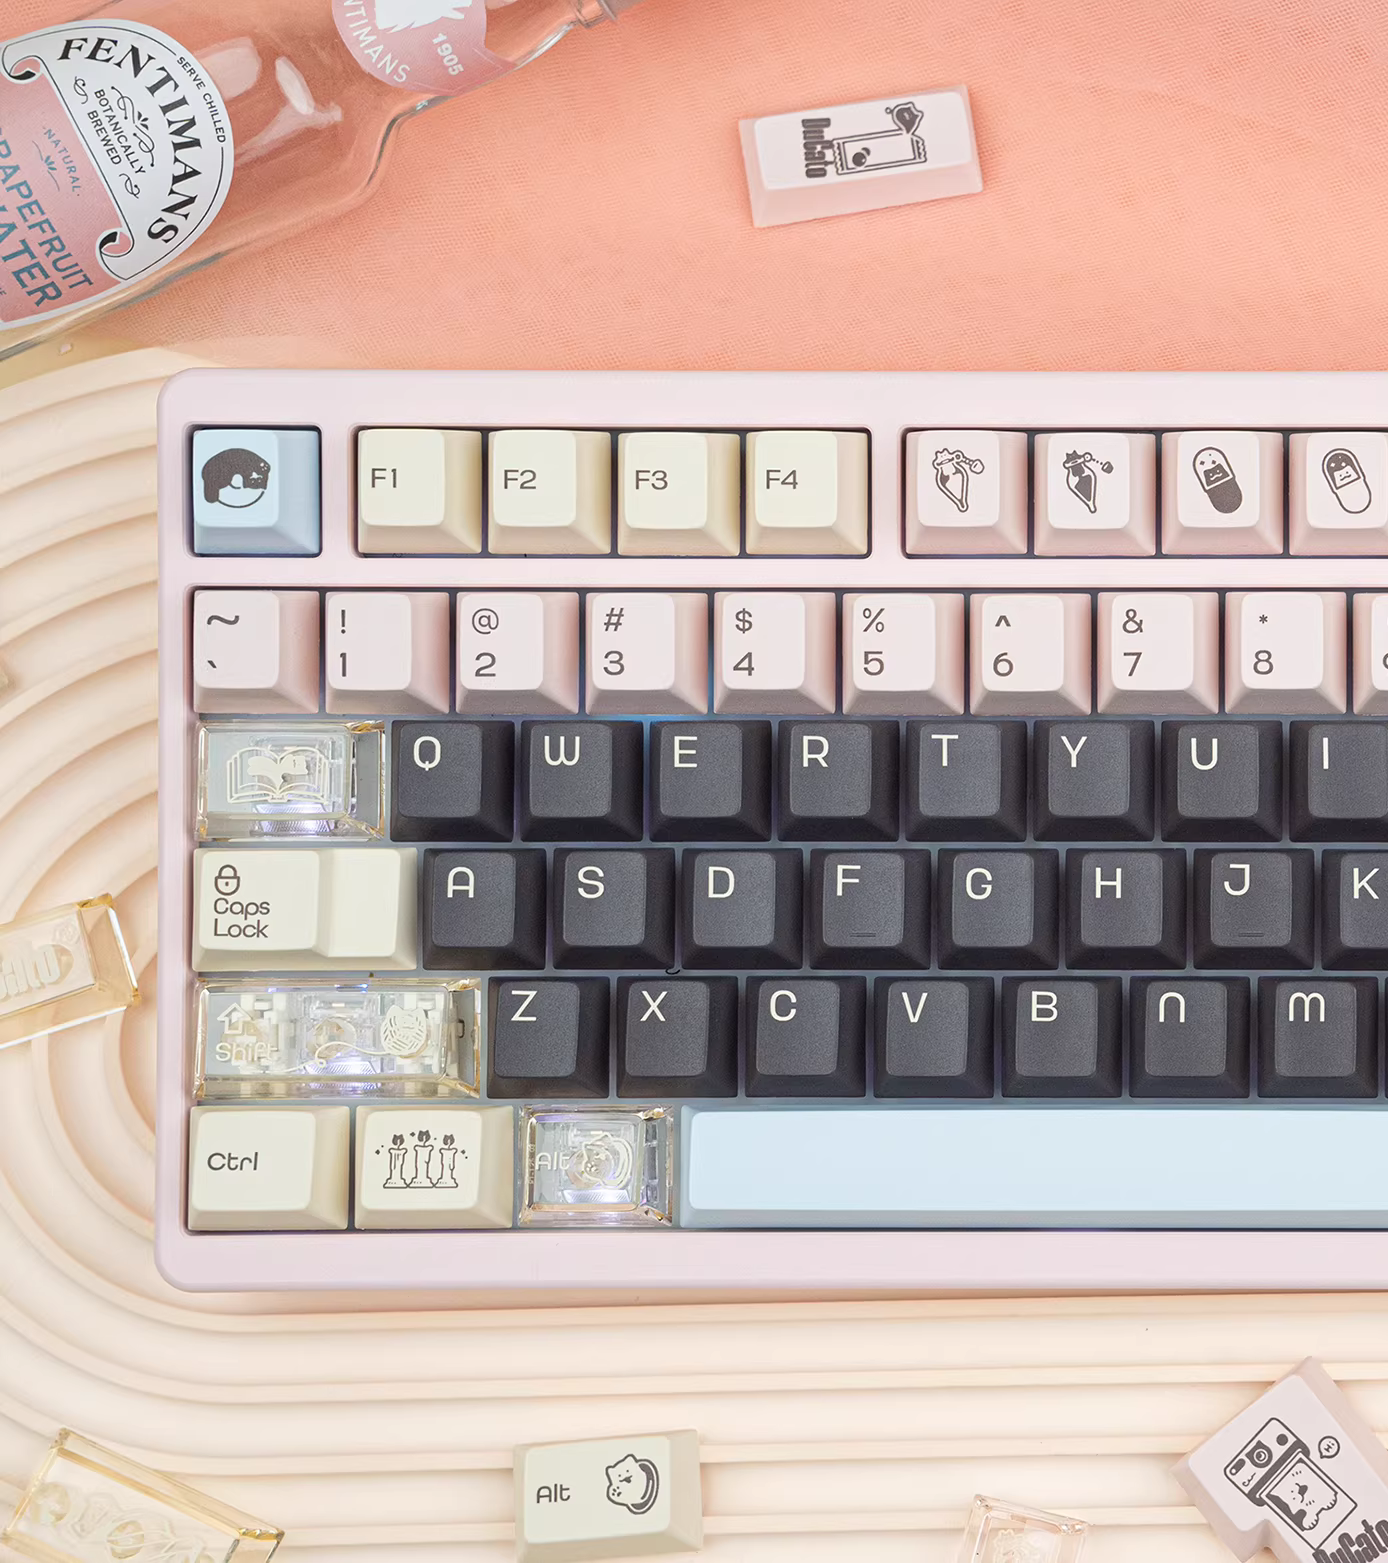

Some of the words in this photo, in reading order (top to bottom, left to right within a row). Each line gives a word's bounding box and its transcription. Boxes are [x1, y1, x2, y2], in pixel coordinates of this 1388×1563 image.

[432, 33, 464, 75] 1905
[177, 56, 206, 90] SERVE
[203, 93, 227, 143] CHILLED
[57, 37, 202, 244] FENTIMANS
[88, 110, 122, 165] BREWED
[94, 89, 146, 175] BOTANICALLY
[371, 467, 397, 489] F1
[503, 469, 537, 490] F2
[635, 469, 668, 491] F3
[766, 469, 799, 490] F4
[206, 614, 240, 626] ~
[340, 609, 346, 635] !
[471, 608, 499, 635] @
[603, 607, 625, 632] #
[735, 607, 753, 634] $
[862, 607, 885, 633] %
[994, 614, 1012, 628] ^
[1122, 608, 1144, 634] &
[339, 652, 347, 678] 1
[474, 652, 496, 677] 2
[603, 650, 625, 676] 3
[732, 651, 755, 677] 4
[863, 650, 885, 676] 5
[993, 652, 1014, 677] 6
[1123, 651, 1143, 677] 7
[1253, 649, 1274, 675] 8
[413, 735, 441, 772] Q
[544, 735, 581, 766] W
[674, 735, 698, 768] E
[802, 735, 829, 768] R
[931, 734, 959, 767] T
[1060, 735, 1088, 768] Y
[1190, 737, 1218, 771] U
[1322, 737, 1329, 770] I
[447, 866, 475, 898] A
[577, 866, 605, 899] S
[708, 866, 735, 898] D
[836, 864, 861, 897] F
[965, 867, 993, 900] G
[1095, 867, 1122, 899] H
[1223, 863, 1250, 896] J
[1353, 867, 1380, 900] K
[213, 897, 271, 918] Caps
[213, 918, 269, 938] Lock
[510, 990, 538, 1022] Z
[640, 990, 668, 1022] X
[770, 989, 797, 1022] C
[901, 991, 928, 1023] V
[1031, 990, 1058, 1022] B
[215, 1042, 277, 1062] Shift
[207, 1151, 259, 1171] Ctrl
[536, 1152, 570, 1170] Alt
[536, 1483, 571, 1504] Alt
